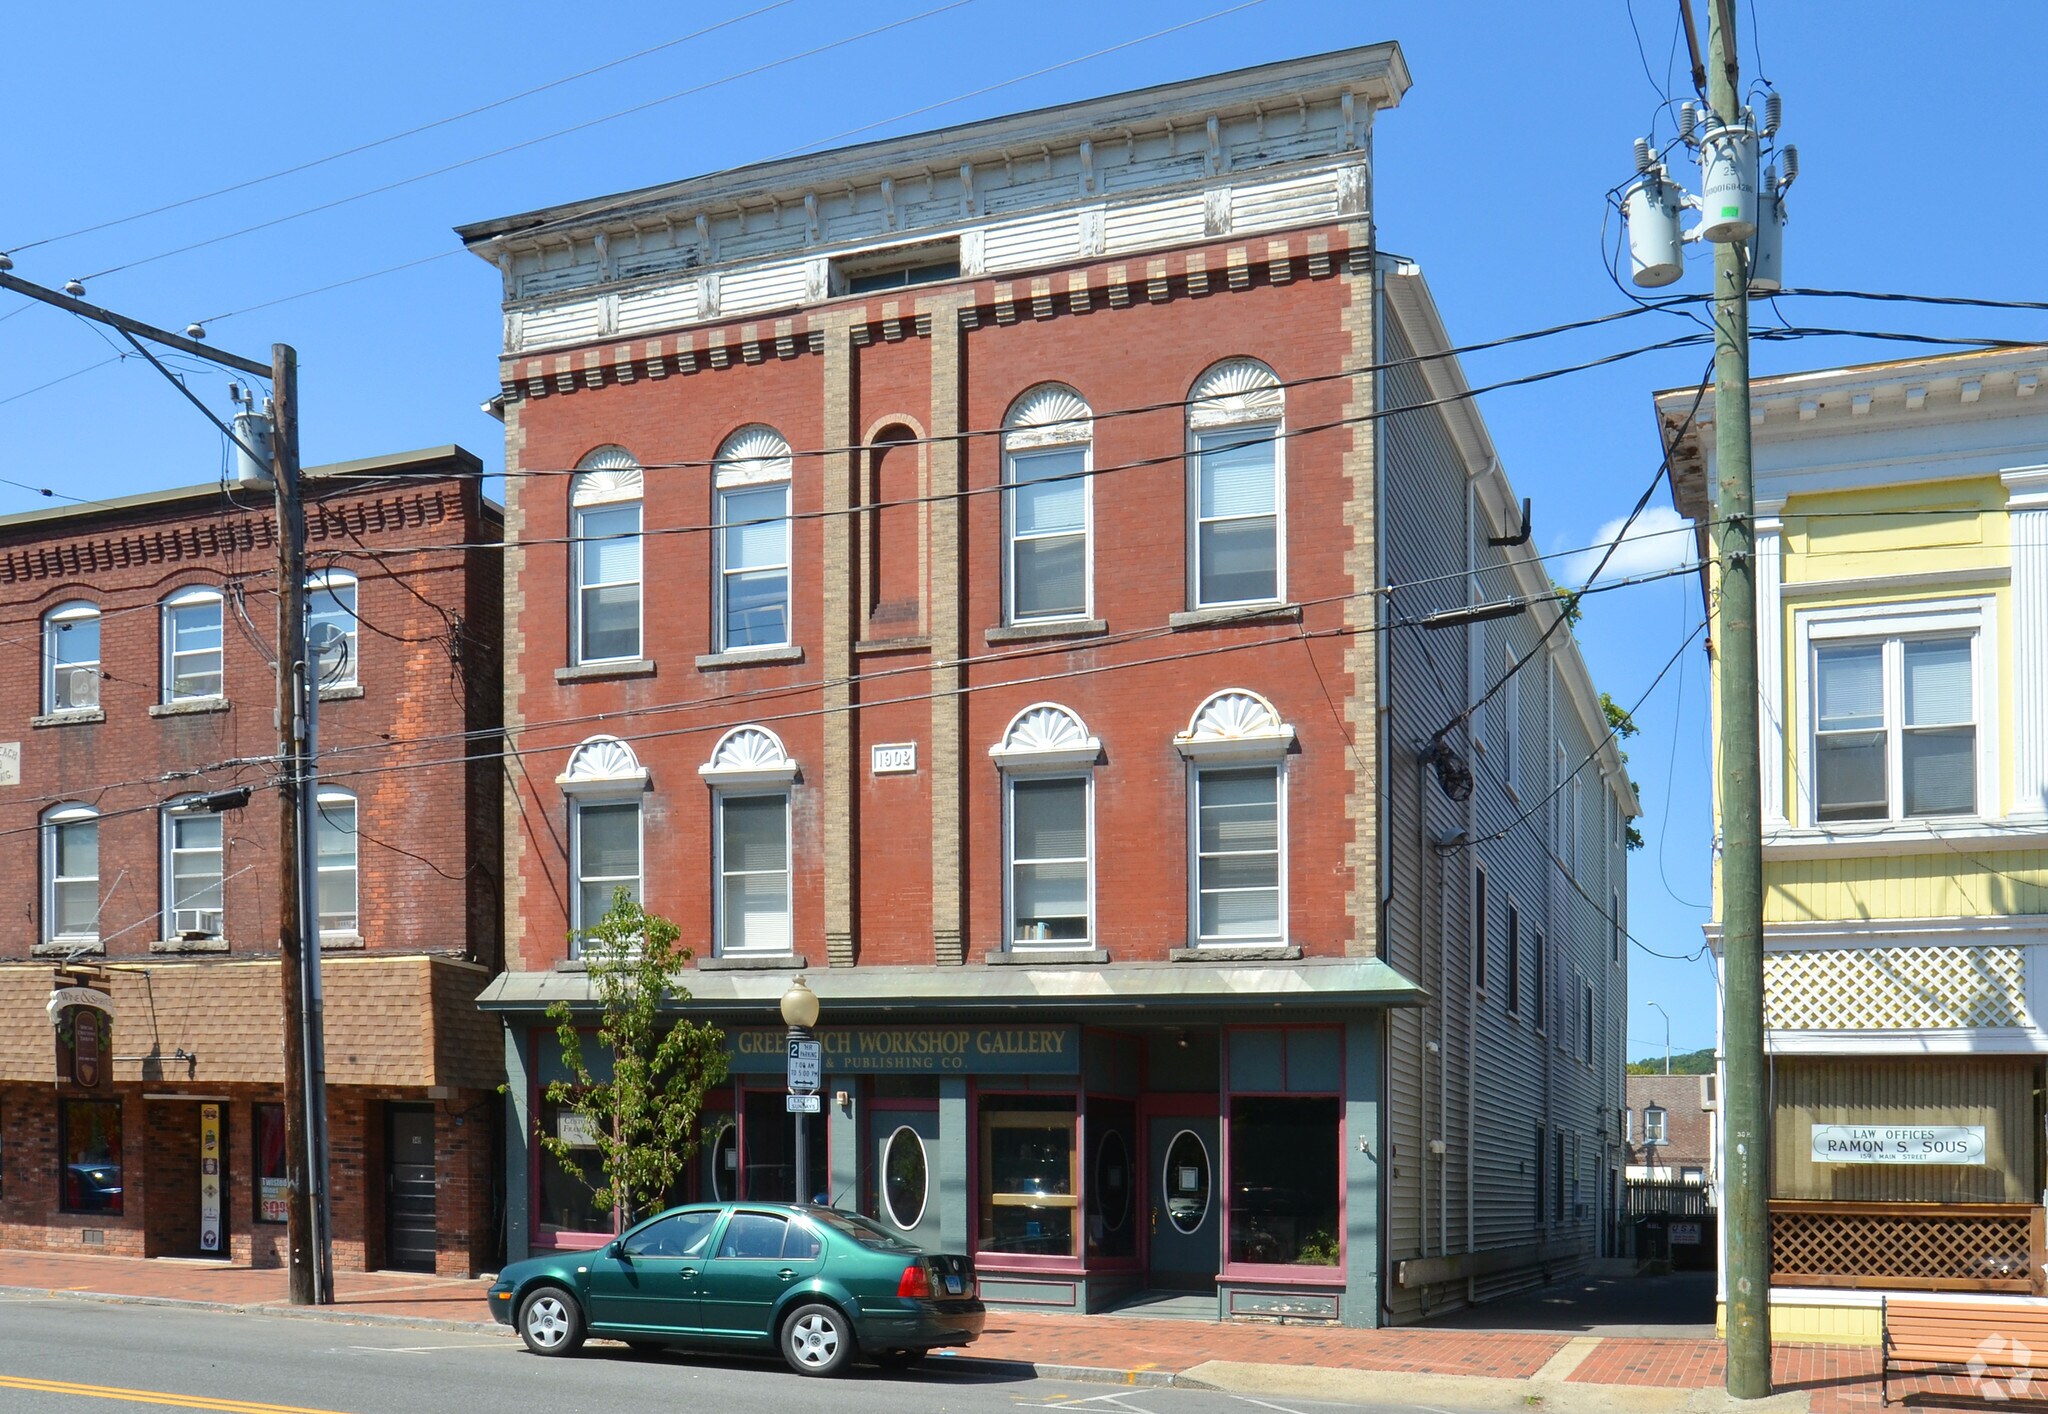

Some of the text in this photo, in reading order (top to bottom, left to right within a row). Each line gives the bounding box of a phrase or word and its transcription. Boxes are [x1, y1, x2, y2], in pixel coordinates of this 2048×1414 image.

[879, 750, 911, 768] 1902
[738, 1030, 1066, 1054] GREEICH WORKSHOP GALLERY
[790, 1044, 798, 1057] 2
[800, 1050, 817, 1059] PARKING
[825, 1056, 968, 1068] & PUBLISHING CO.
[1853, 1129, 1934, 1140] LAW OFFICES
[1828, 1140, 1968, 1153] RAMON S. SOUS
